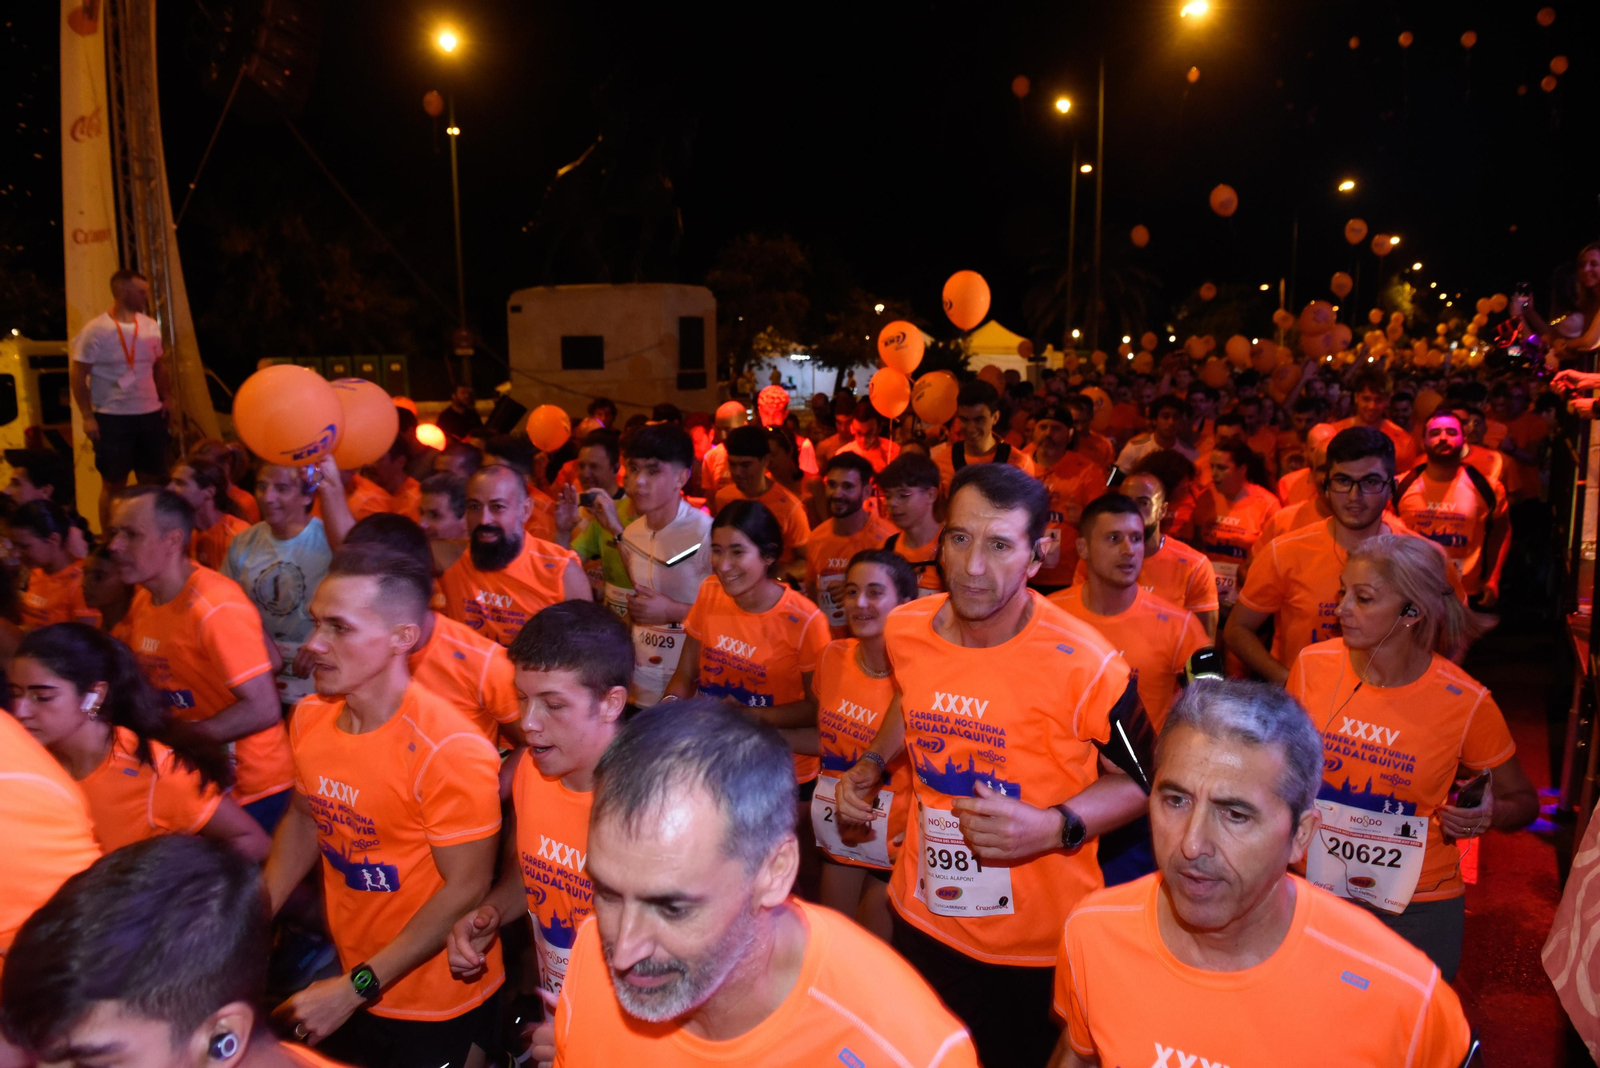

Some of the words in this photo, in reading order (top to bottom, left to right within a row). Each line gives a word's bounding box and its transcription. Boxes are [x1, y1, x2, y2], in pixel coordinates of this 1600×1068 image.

[640, 631, 676, 649] 18029
[837, 699, 878, 725] XXXV
[930, 691, 990, 719] XXXV
[909, 709, 951, 724] CARRERA
[955, 718, 1007, 736] NOCTURNA
[915, 720, 1007, 750] GUADALQUIVIR
[1339, 716, 1401, 747] XXXV
[1323, 741, 1415, 774] UADALQUIVIR
[1361, 743, 1417, 763] NOCTURNA
[317, 775, 360, 808] XXXV
[521, 851, 554, 873] CARRERA
[537, 834, 587, 873] XXXV
[926, 846, 982, 873] 3981
[1327, 837, 1402, 869] 20622
[524, 864, 595, 906] GUADALQUIVI
